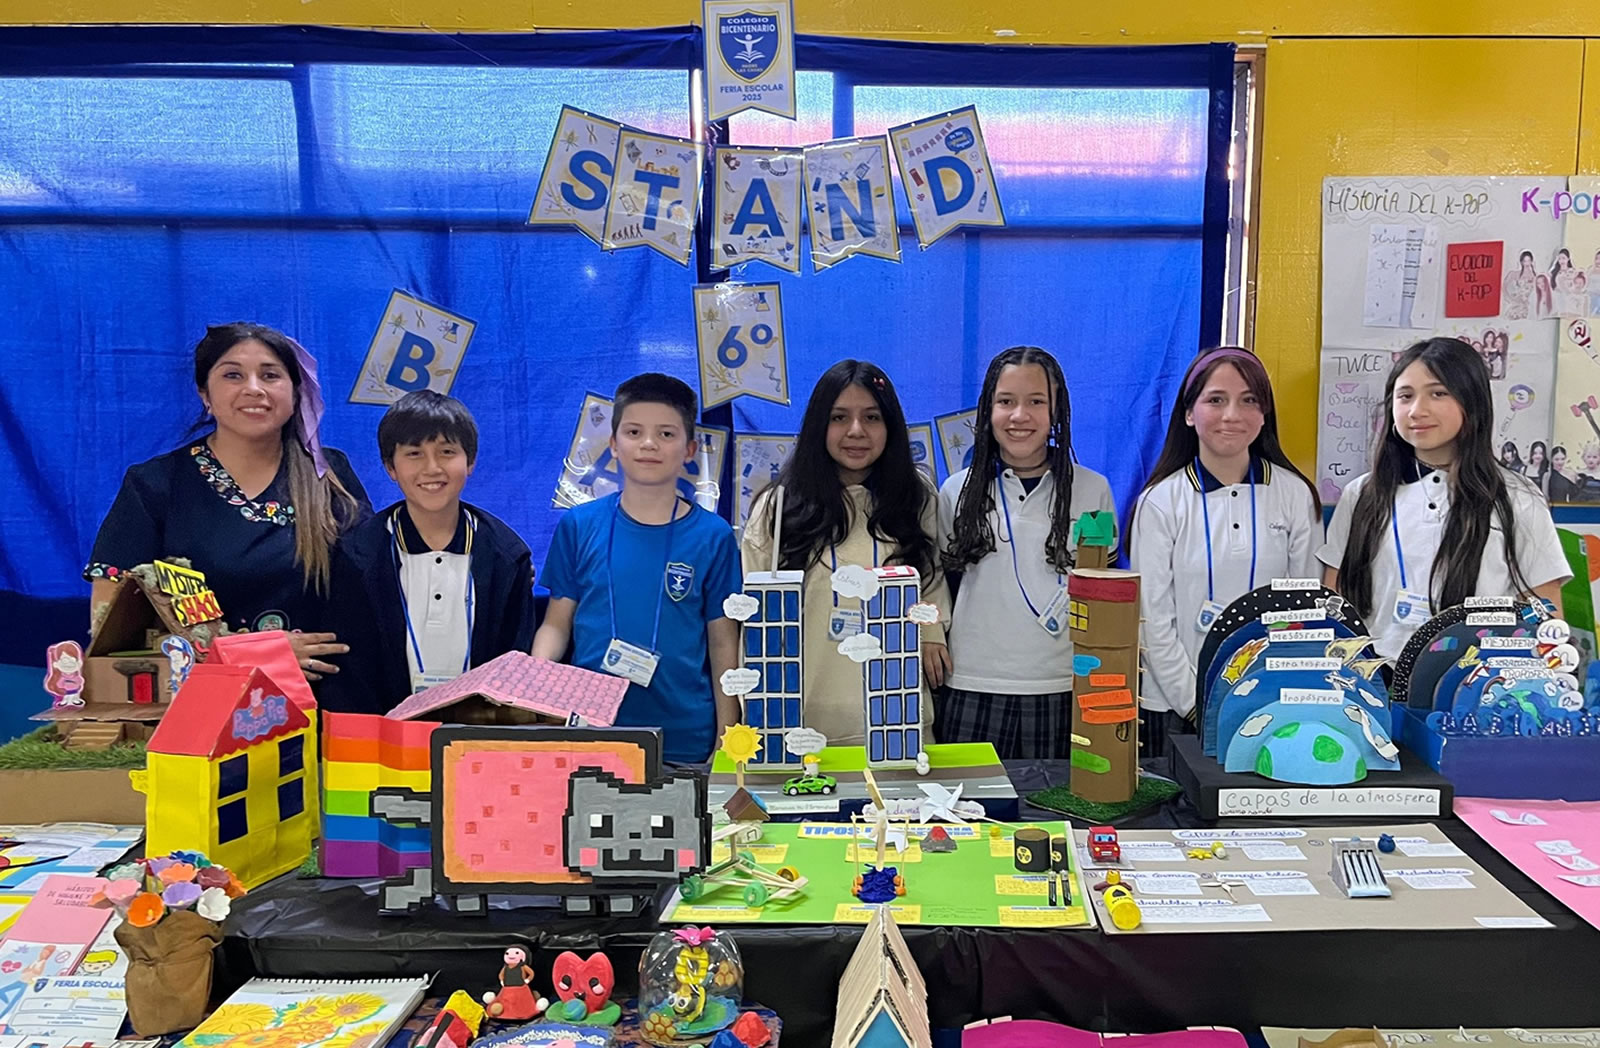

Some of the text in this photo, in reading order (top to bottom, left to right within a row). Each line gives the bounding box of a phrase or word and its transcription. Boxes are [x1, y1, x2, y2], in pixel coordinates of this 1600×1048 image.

[721, 24, 776, 34] BICENTENARIO
[720, 83, 784, 93] FERIA ESCOLAR
[1407, 191, 1440, 214] DEL
[385, 330, 436, 391] B
[1299, 790, 1320, 806] de
[1330, 790, 1350, 804] la
[803, 826, 860, 836] TIPOS
[53, 979, 80, 988] FERIA
